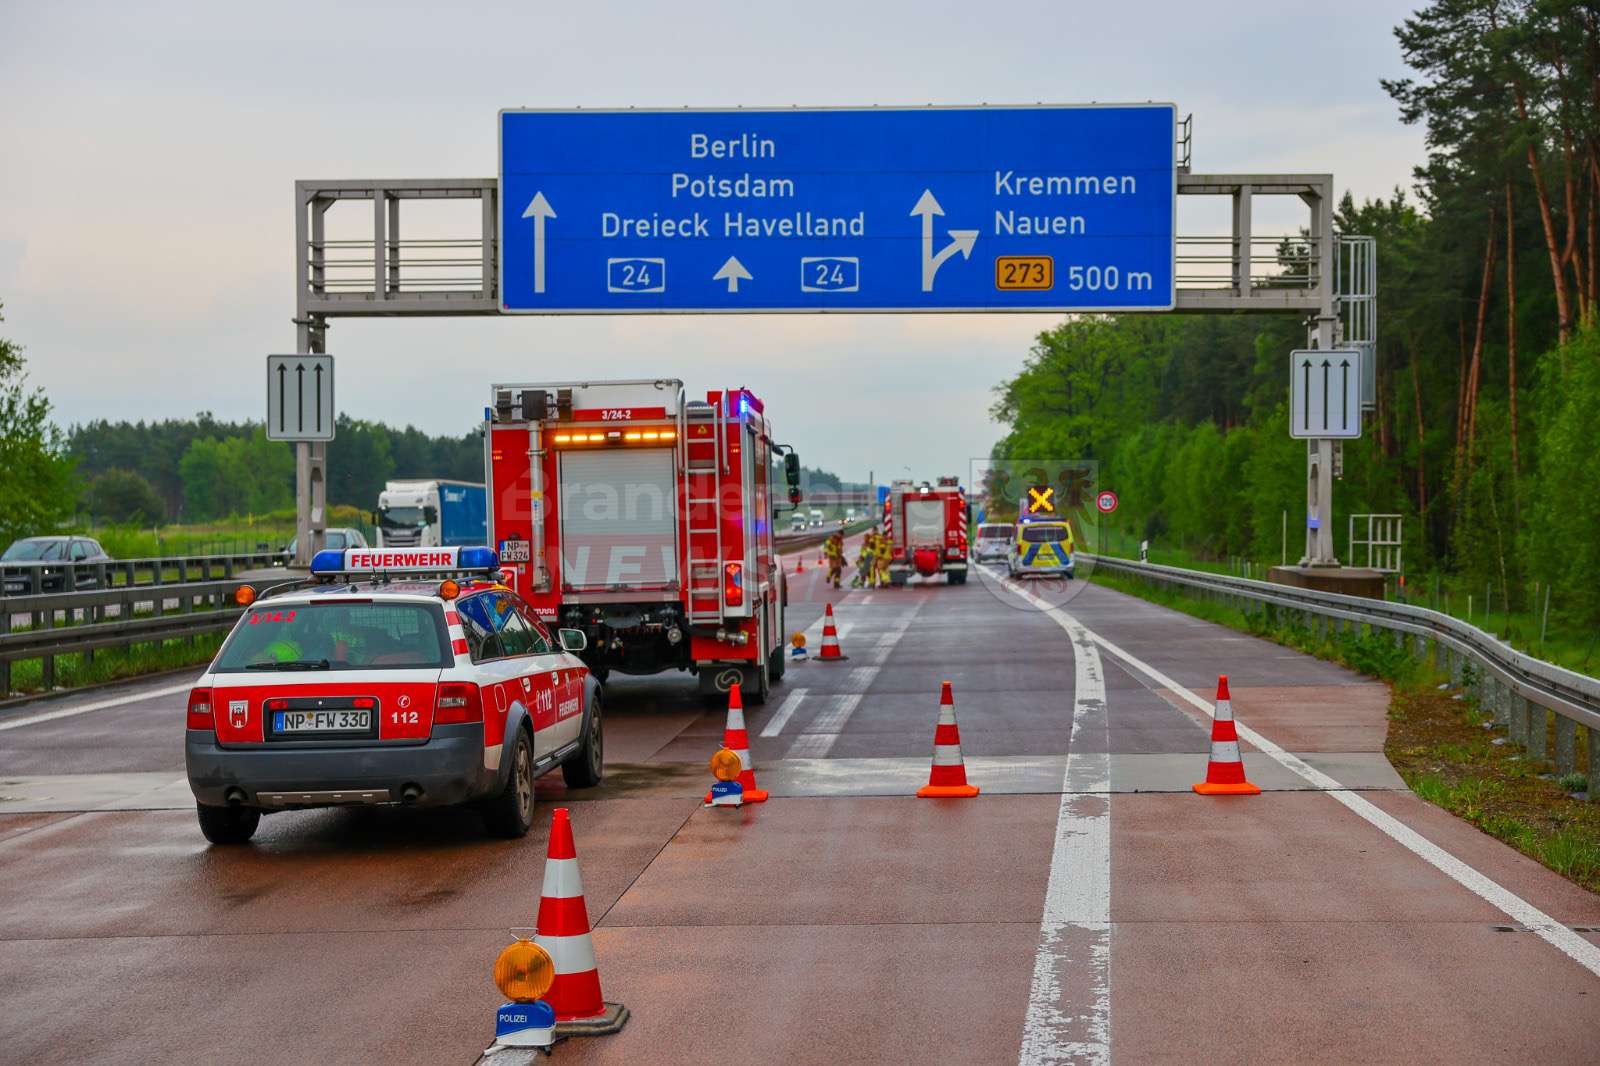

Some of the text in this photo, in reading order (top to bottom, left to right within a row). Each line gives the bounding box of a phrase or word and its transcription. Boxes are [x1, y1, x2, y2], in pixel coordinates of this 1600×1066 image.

[690, 133, 776, 158] Berlin
[671, 173, 795, 198] Potsdam
[994, 170, 1137, 196] Kremmen
[601, 211, 866, 238] Dreieck Havelland
[994, 210, 1086, 235] Nauen
[622, 265, 651, 286] 24
[815, 264, 845, 285] 24
[1004, 263, 1045, 283] 273
[1069, 266, 1153, 291] 500 m
[601, 409, 631, 420] 3/24-2
[507, 542, 520, 551] NP
[513, 551, 528, 560] 324
[351, 553, 452, 567] FEUERWEHR
[284, 711, 369, 729] NP FW 330
[391, 711, 418, 723] 112
[499, 1014, 528, 1023] POLIZEI
